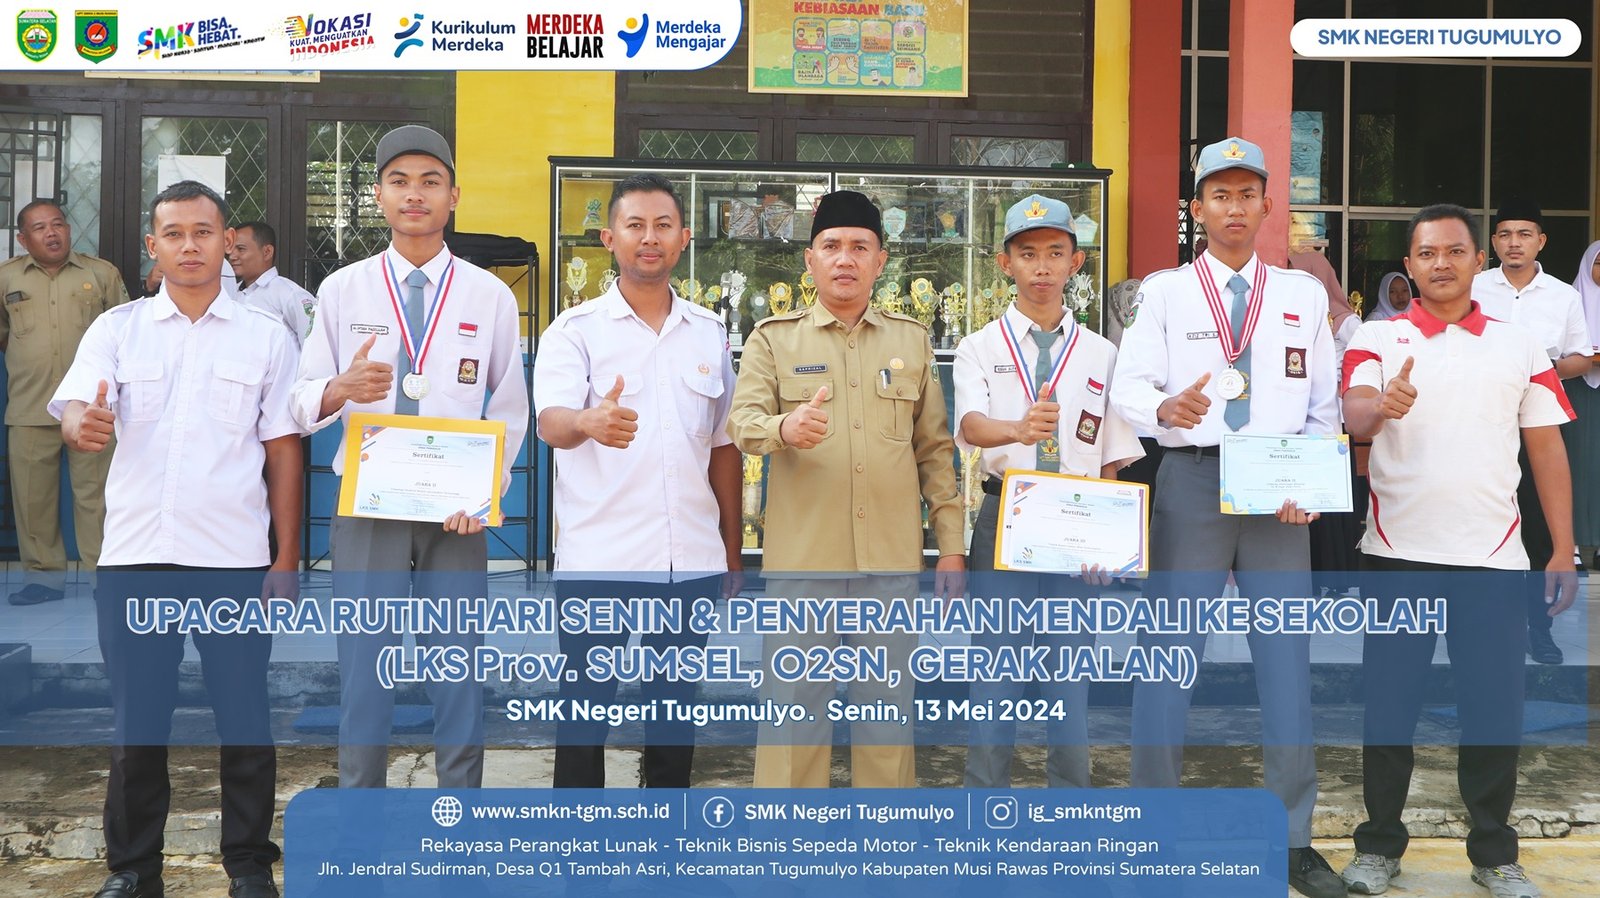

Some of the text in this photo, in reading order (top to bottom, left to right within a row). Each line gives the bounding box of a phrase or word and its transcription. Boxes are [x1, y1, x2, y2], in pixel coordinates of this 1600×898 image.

[794, 2, 880, 16] KEBIASAAN
[412, 451, 445, 460] Sertifikat
[1060, 508, 1092, 517] Sertifikat
